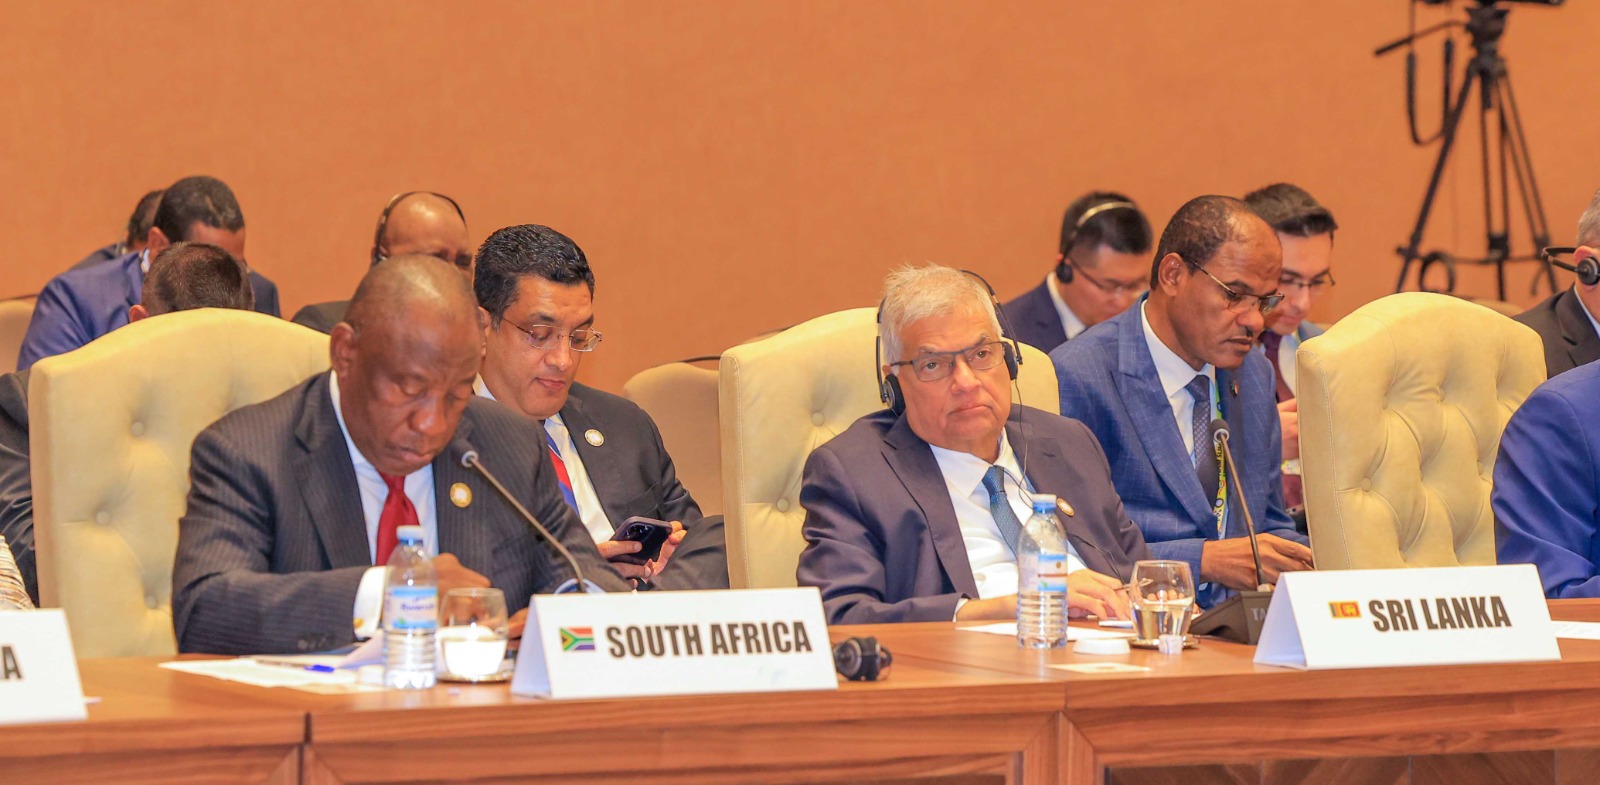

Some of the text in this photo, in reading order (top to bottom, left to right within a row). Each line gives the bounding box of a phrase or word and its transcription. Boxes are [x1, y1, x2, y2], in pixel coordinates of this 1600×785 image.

[1368, 596, 1512, 632] SRI LANKA
[606, 622, 812, 658] SOUTH AFRICA
